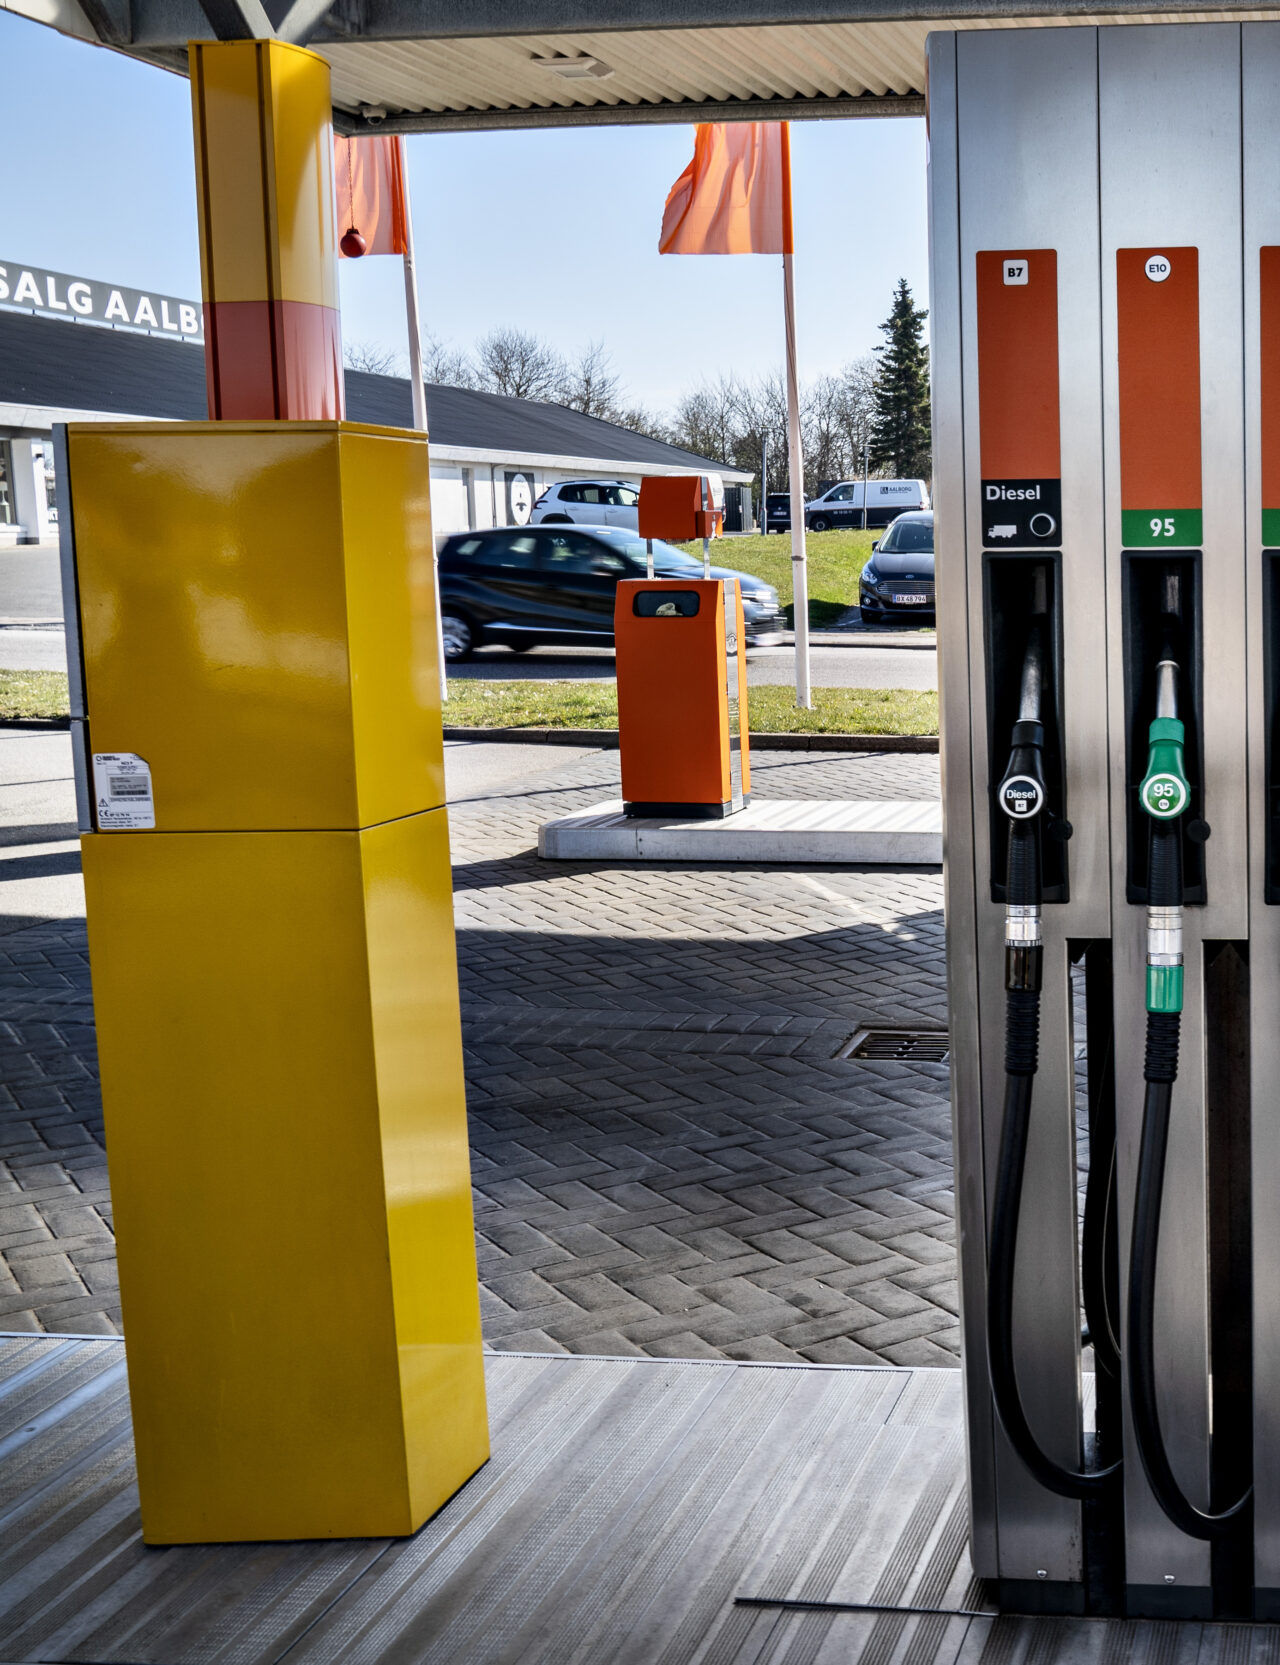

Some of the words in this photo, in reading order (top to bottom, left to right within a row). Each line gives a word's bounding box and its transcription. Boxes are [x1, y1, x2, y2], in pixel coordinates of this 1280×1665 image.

[1007, 267, 1024, 279] B7
[1148, 263, 1167, 273] E10
[104, 290, 205, 336] AALB
[985, 484, 1041, 501] Diesel
[1149, 518, 1176, 537] 95
[1006, 789, 1036, 799] Diesel
[1153, 783, 1174, 797] 95
